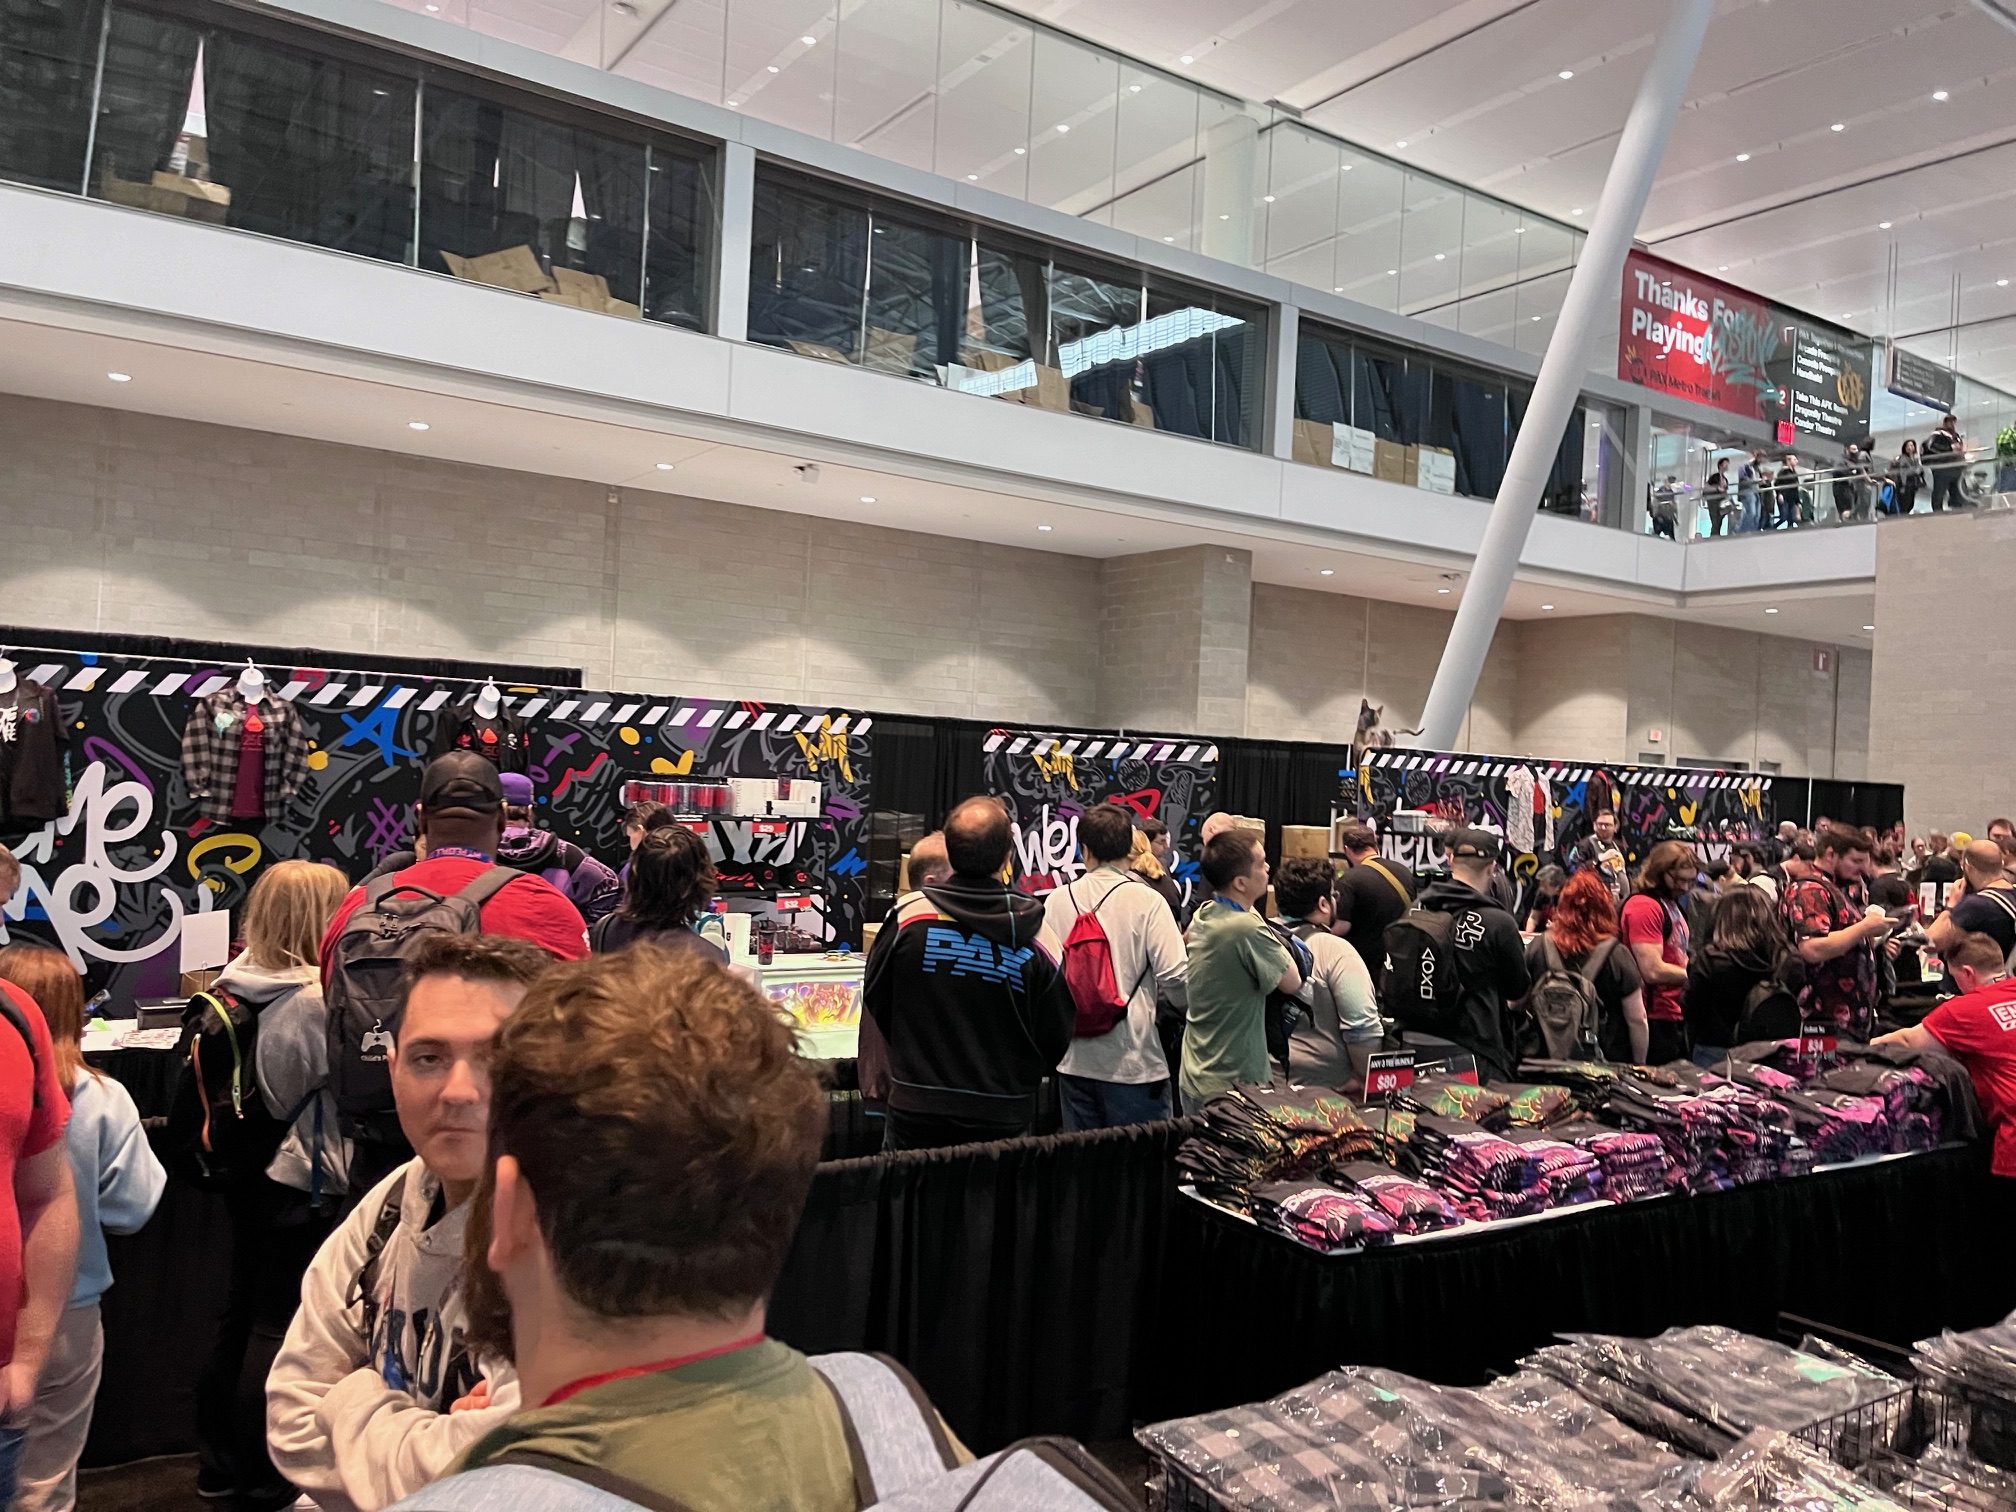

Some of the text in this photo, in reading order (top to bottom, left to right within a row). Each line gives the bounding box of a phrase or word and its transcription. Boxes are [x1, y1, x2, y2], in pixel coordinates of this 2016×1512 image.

[1635, 270, 1708, 321] Thanks
[1779, 390, 1786, 404] 2
[922, 927, 1035, 993] PAX
